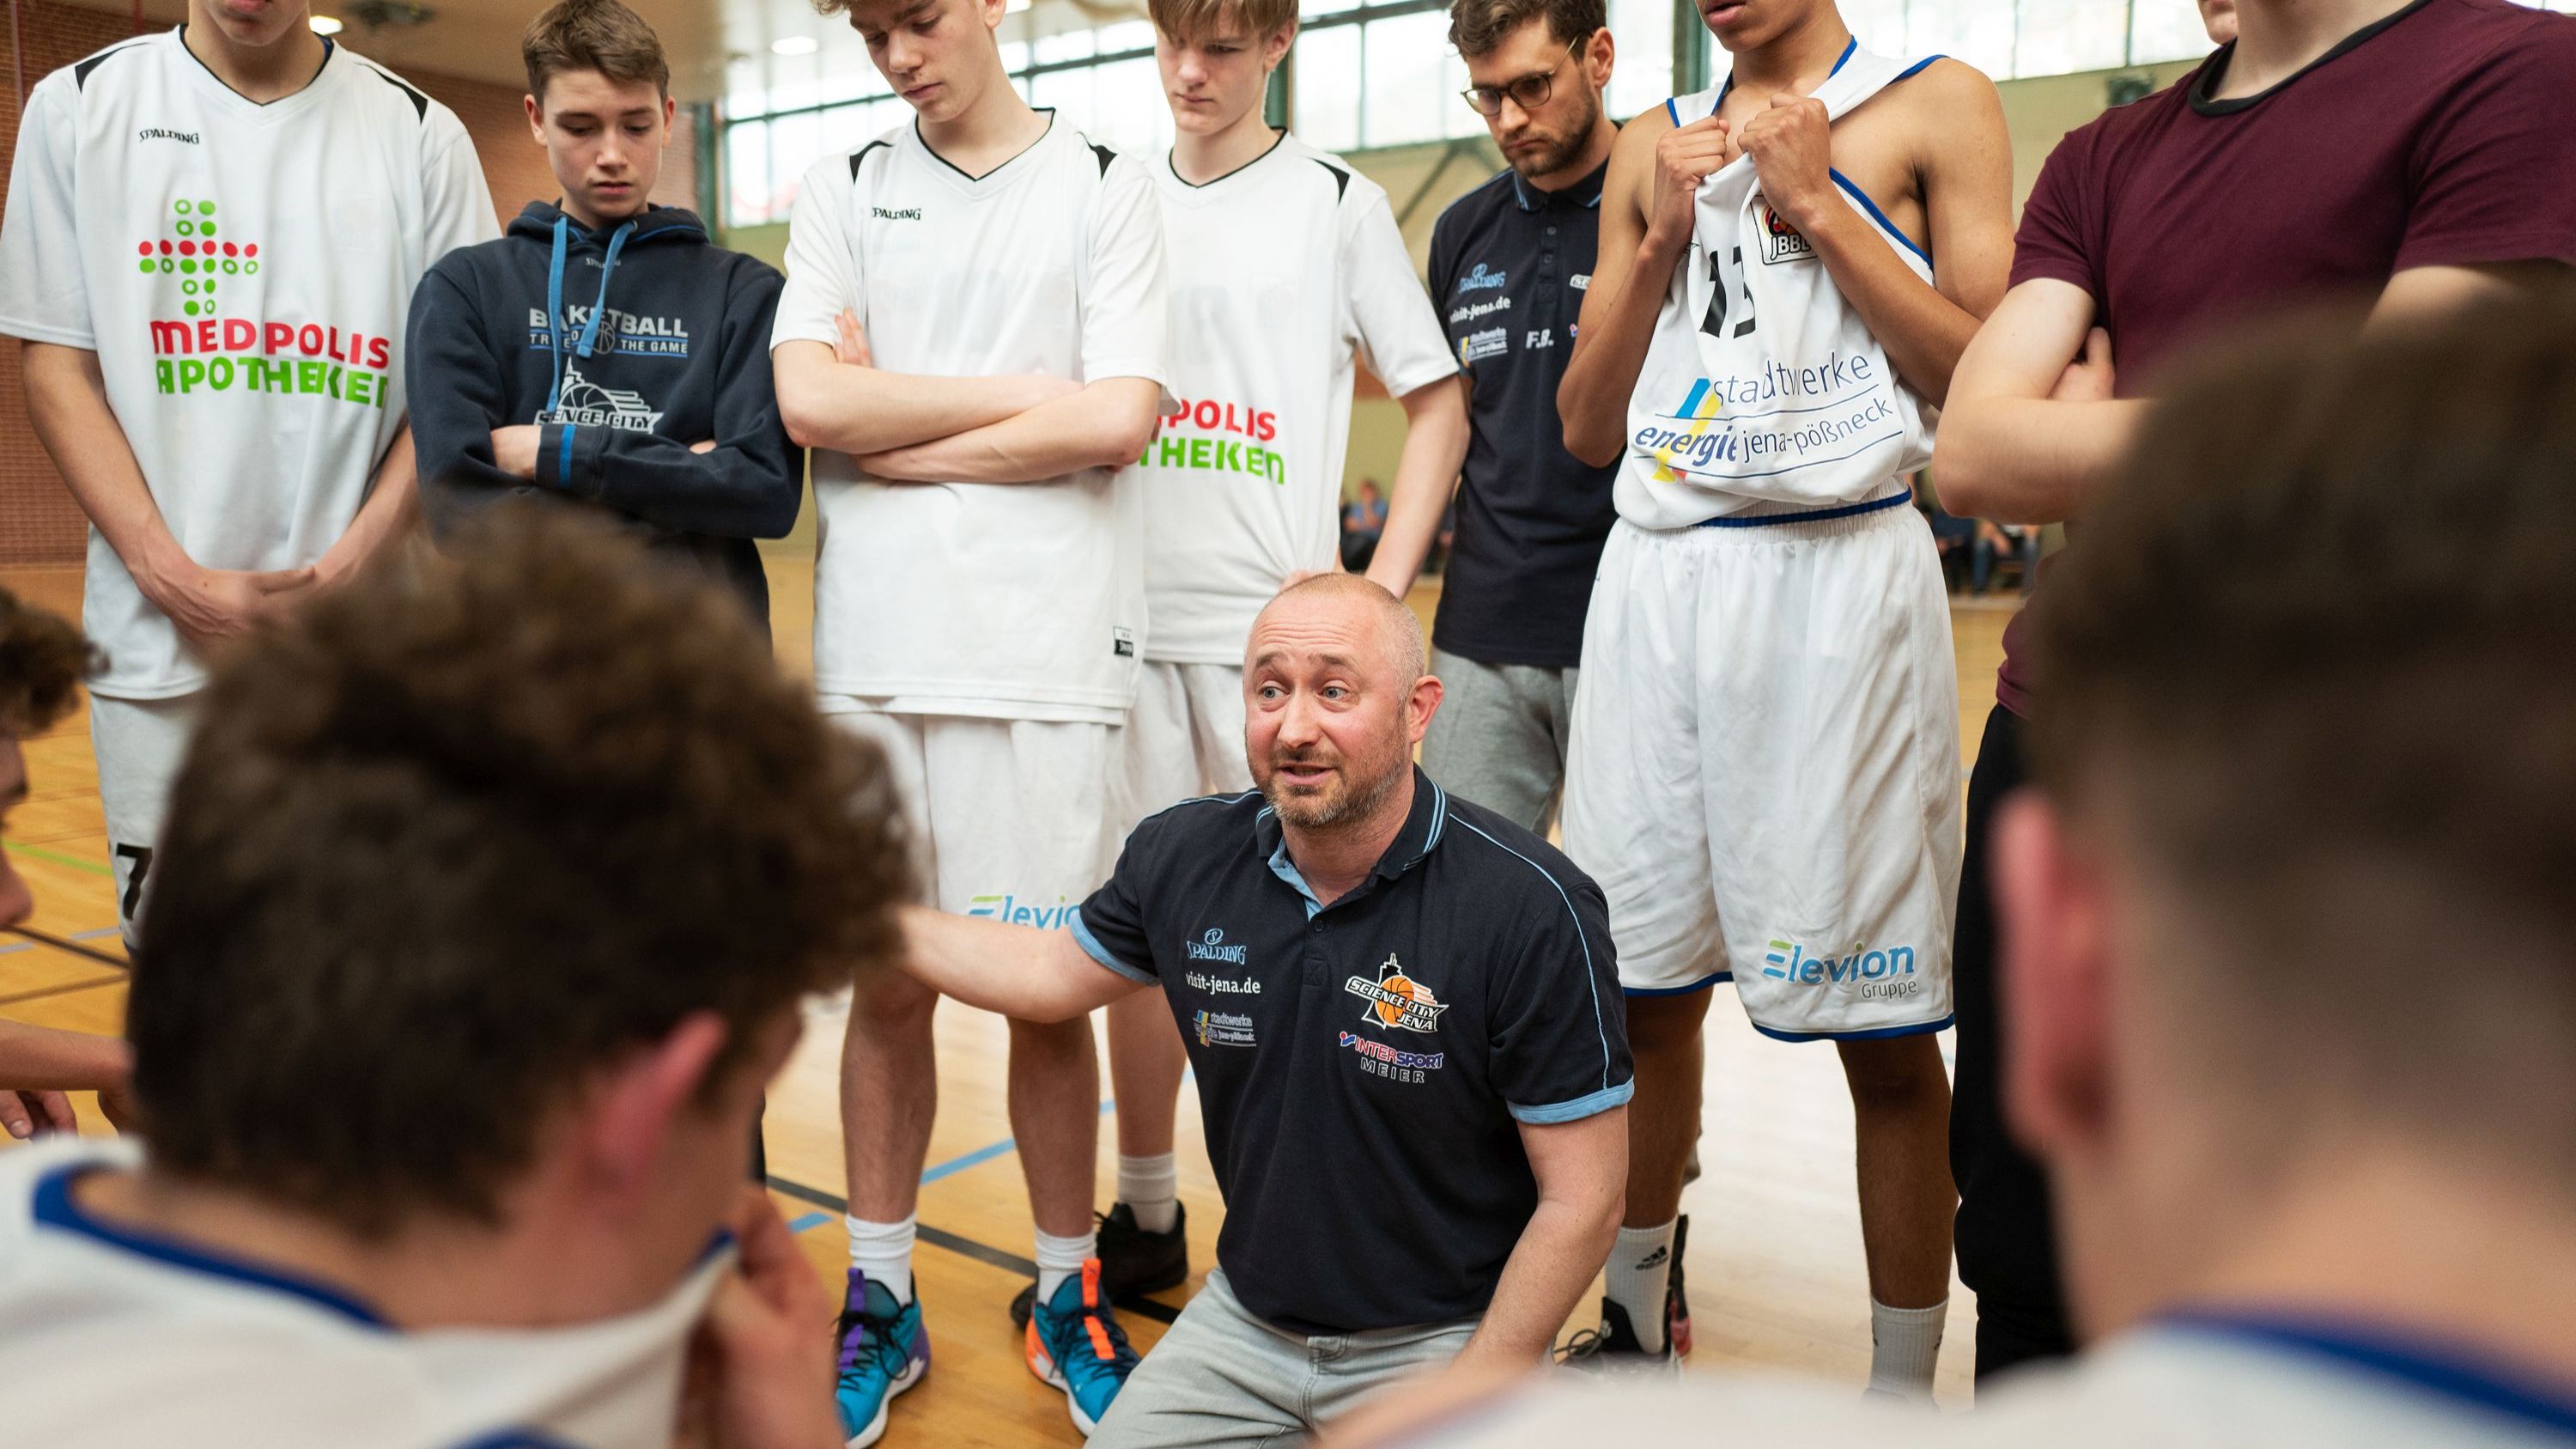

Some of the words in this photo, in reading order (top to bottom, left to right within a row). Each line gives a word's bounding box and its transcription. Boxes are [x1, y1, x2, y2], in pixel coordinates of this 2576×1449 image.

[139, 128, 199, 144] SPALDING
[872, 207, 921, 221] PALDING
[530, 333, 571, 349] TRE
[620, 339, 645, 352] THE
[650, 340, 688, 354] GAME
[1713, 351, 1873, 406] stadtwerke
[1157, 399, 1276, 441] POLIS
[1634, 425, 1738, 467] energie
[1743, 398, 1893, 463] jena-pößneck
[116, 843, 153, 922] 7
[1187, 941, 1247, 965] SPALDING
[1762, 939, 1916, 985] Elevion
[1186, 971, 1261, 995] visit-jena.de
[1861, 980, 1917, 1000] Gruppe
[1349, 978, 1406, 1008] SCIENCE
[1406, 1000, 1439, 1018] CITY
[1210, 1012, 1253, 1027] stadtwerke
[1396, 1013, 1434, 1031] JENA
[1355, 1036, 1444, 1069] INTERSPORT
[1360, 1056, 1425, 1084] MEIER
